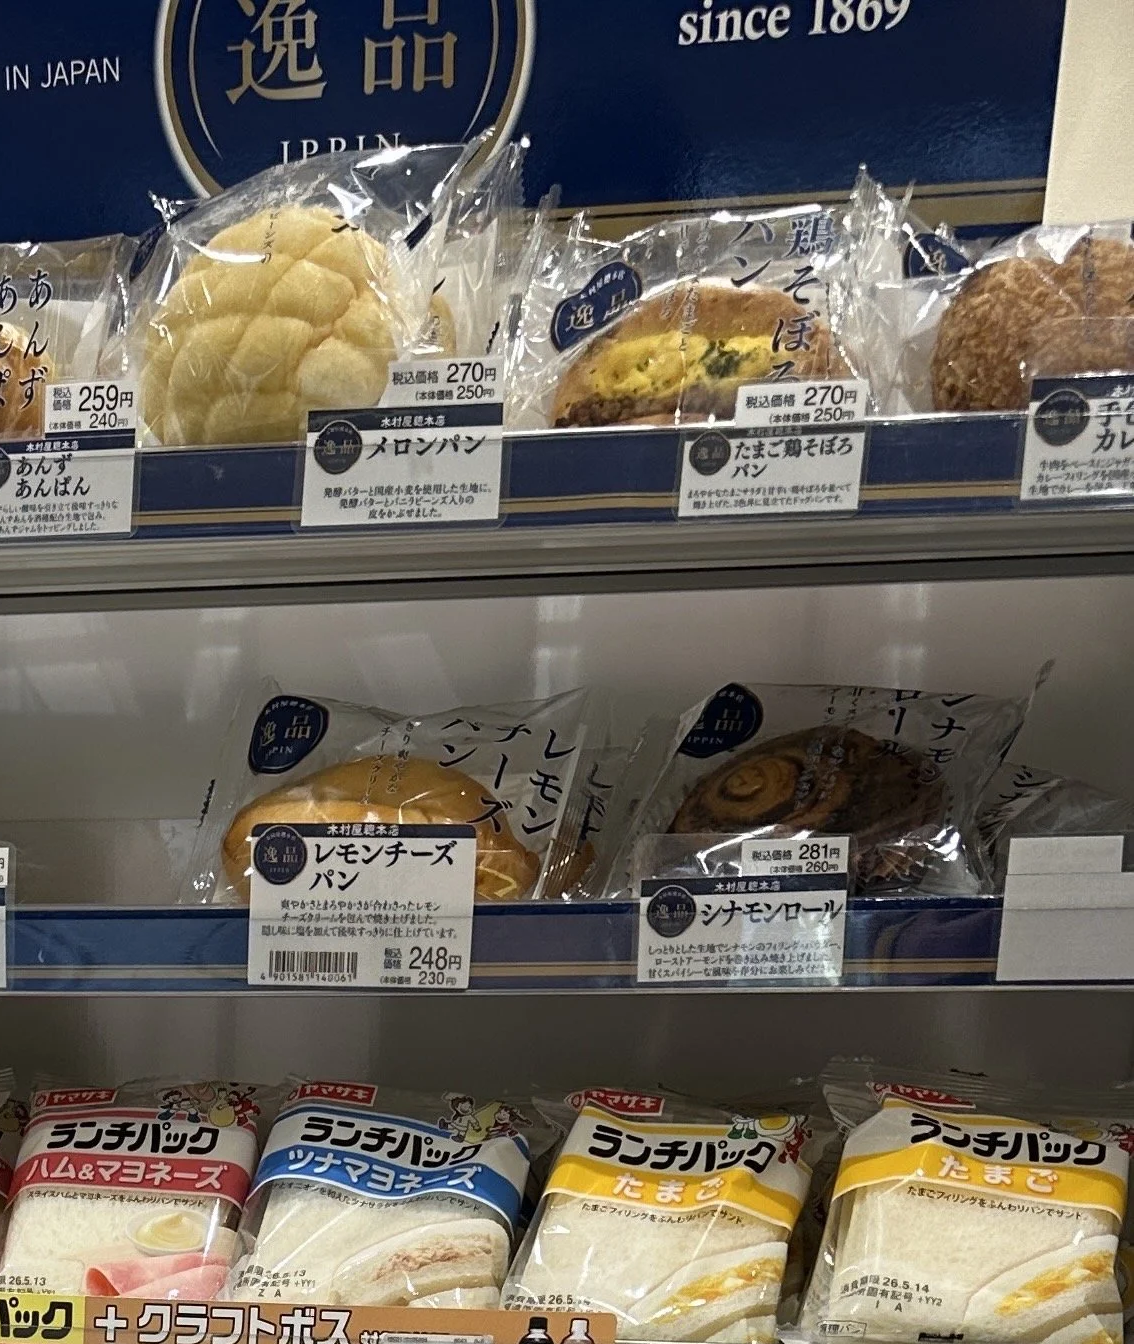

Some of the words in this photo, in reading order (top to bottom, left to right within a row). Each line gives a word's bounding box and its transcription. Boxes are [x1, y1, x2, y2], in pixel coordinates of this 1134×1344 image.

[677, 0, 790, 46] since
[225, 0, 457, 104] 逸品
[5, 65, 31, 91] IN
[40, 57, 122, 88] JAPAN
[393, 371, 438, 385] 税込価格
[447, 362, 496, 383] 270円
[79, 384, 133, 411] 259円
[746, 395, 795, 408] 税込価格
[804, 387, 857, 405] 270円
[366, 436, 486, 459] メロンパン
[735, 439, 853, 458] たまご鶏そぼろ
[16, 453, 72, 476] あんず
[731, 462, 766, 478] パン
[14, 476, 90, 499] あんぱん
[315, 841, 457, 867] レモンチーズ
[752, 848, 793, 861] 税込価格
[799, 843, 841, 861] 281円
[309, 872, 359, 891] パン
[700, 898, 845, 927] シナモンロール
[408, 946, 462, 970] 248円
[301, 1116, 481, 1168] ランチパック
[911, 1114, 1106, 1165] ランチパック
[288, 1148, 481, 1192] ツナマヨネーズ
[939, 1156, 1059, 1192] たまご
